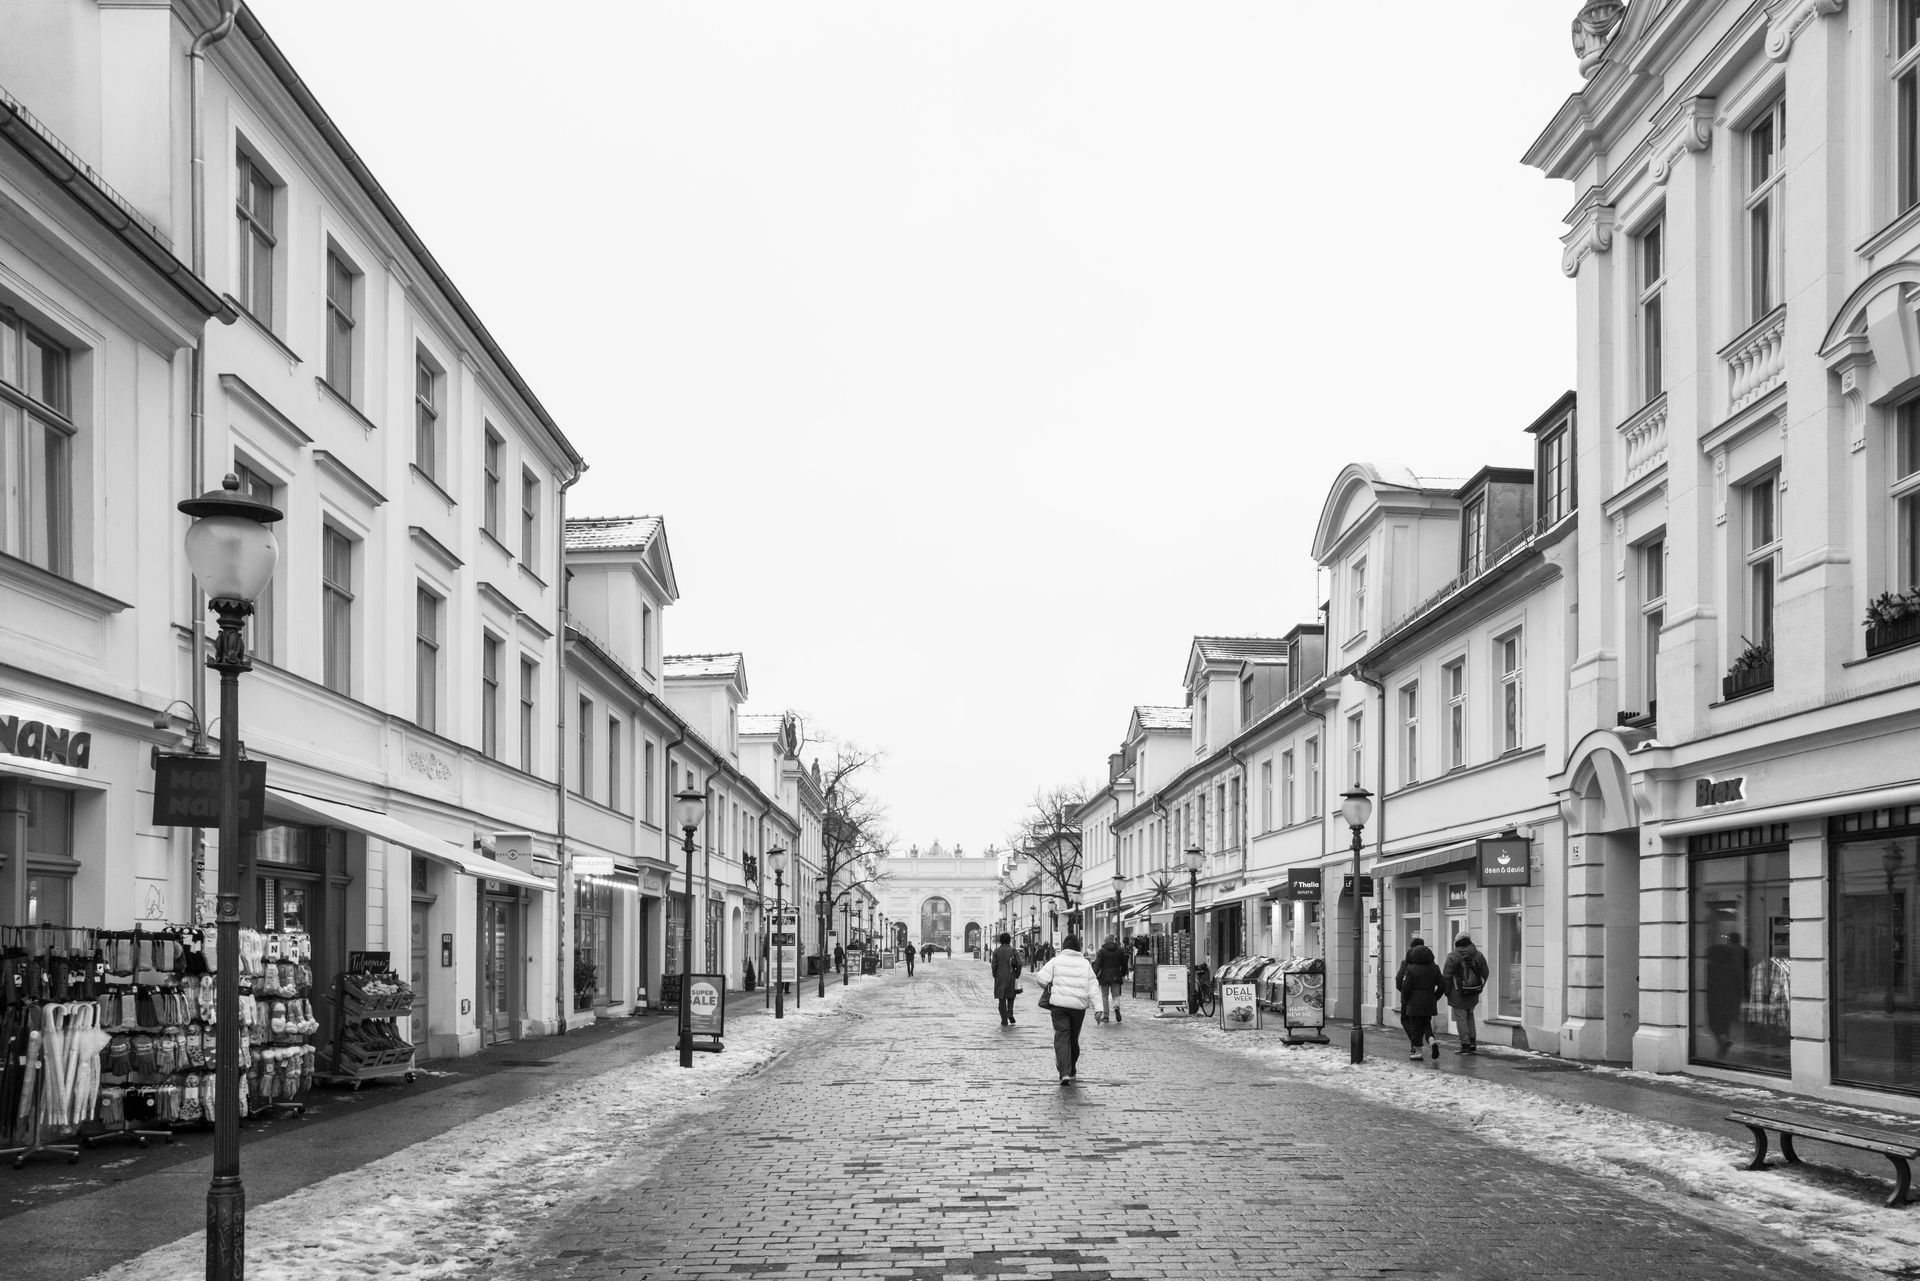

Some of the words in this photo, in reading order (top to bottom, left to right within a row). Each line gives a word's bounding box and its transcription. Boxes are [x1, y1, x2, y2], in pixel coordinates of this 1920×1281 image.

[1696, 777, 1744, 807] Brax
[1501, 866, 1506, 874] &
[1225, 986, 1253, 996] DEAL
[690, 996, 716, 1006] ALE
